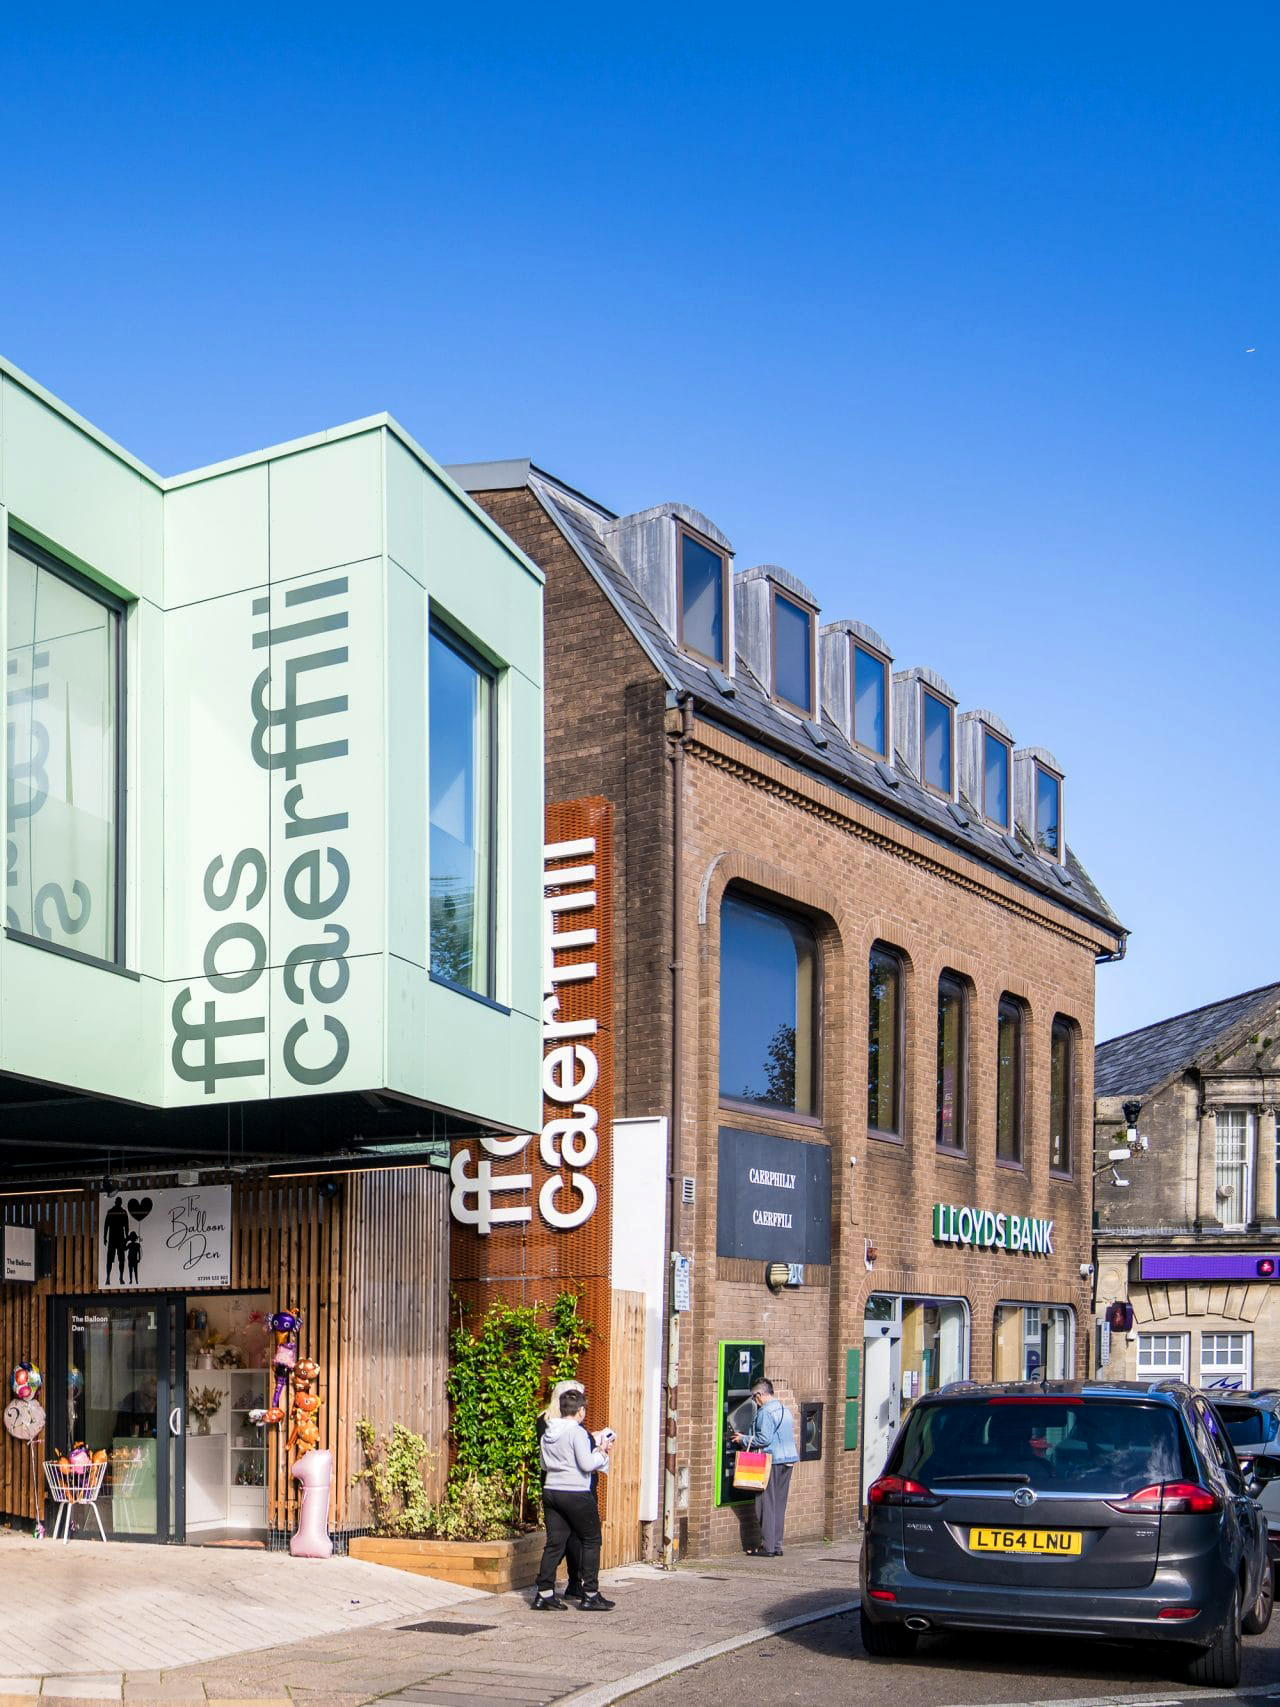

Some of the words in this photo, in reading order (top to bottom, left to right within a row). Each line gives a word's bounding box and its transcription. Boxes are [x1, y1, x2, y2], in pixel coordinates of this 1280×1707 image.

[251, 576, 350, 1085] caerffili
[172, 848, 267, 1094] ffos
[749, 1168, 796, 1189] CAERPHILLY
[181, 1195, 201, 1217] The
[166, 1206, 225, 1248] Balloon
[752, 1209, 792, 1228] CAERFFILI
[938, 1203, 1007, 1248] LLOYDS
[1010, 1215, 1054, 1254] BANK
[178, 1233, 220, 1270] Den
[15, 1259, 32, 1267] Balloon
[147, 1311, 157, 1329] 1
[977, 1531, 1027, 1548] LT64
[1033, 1533, 1072, 1550] LNU
